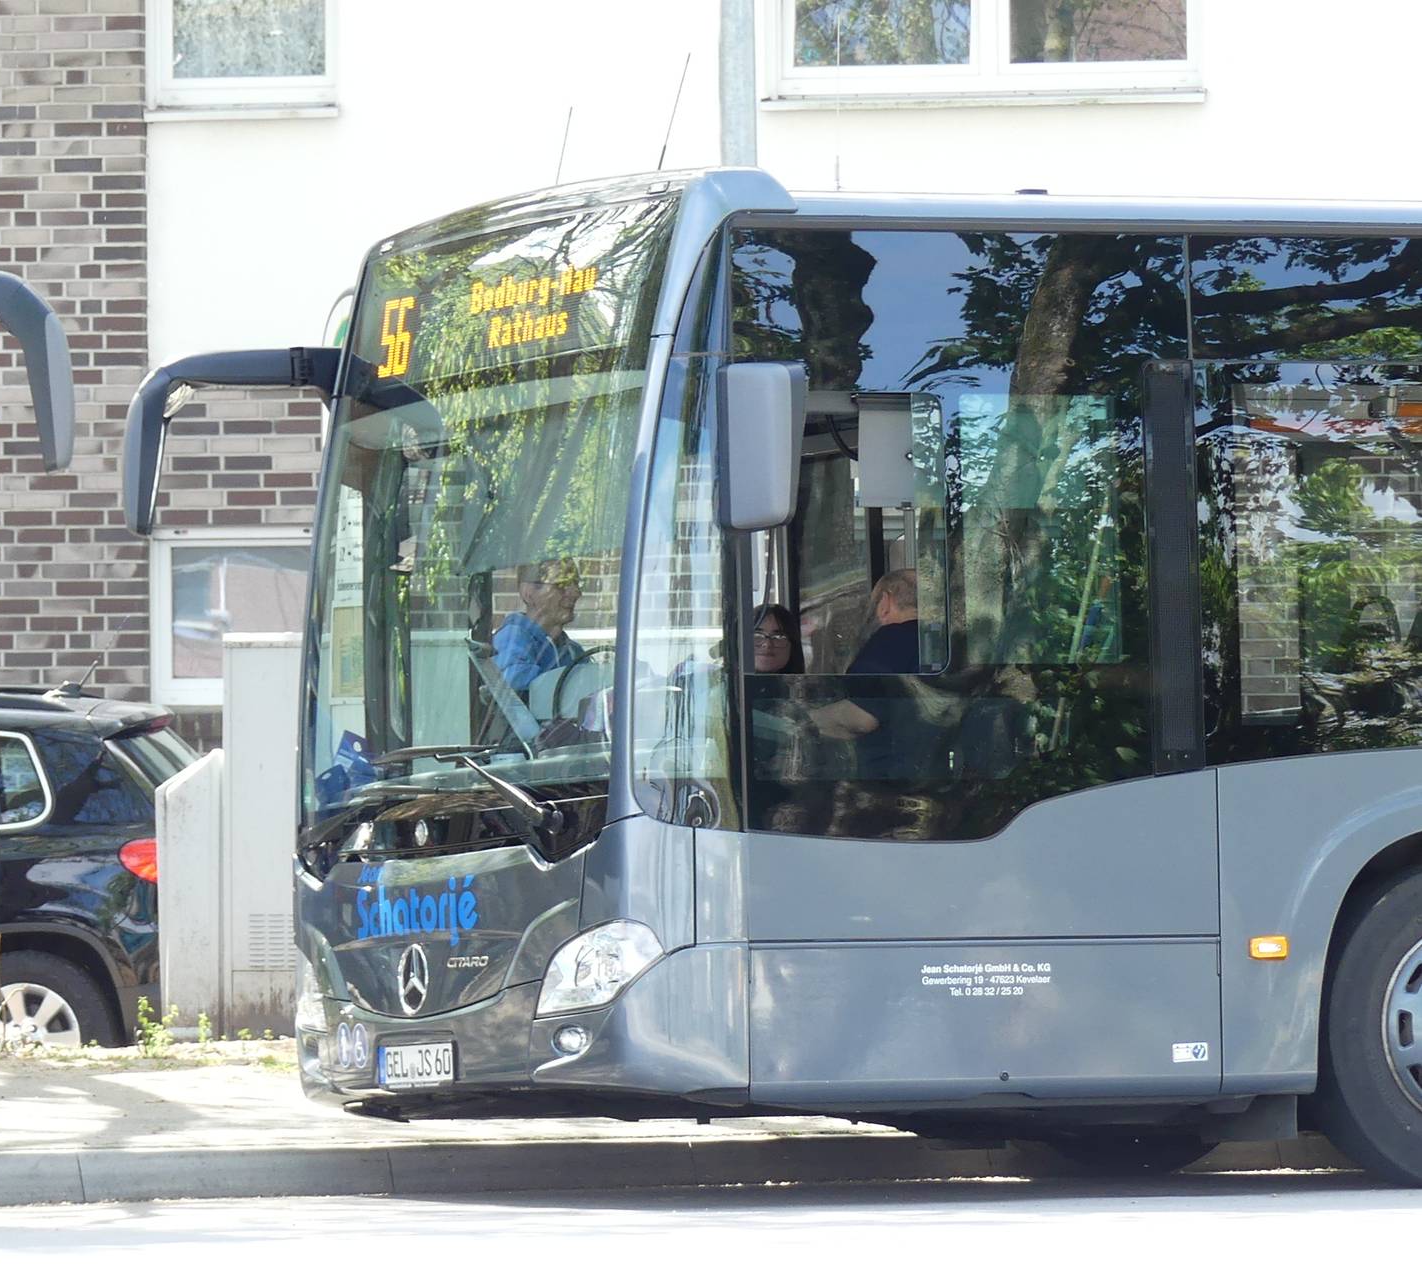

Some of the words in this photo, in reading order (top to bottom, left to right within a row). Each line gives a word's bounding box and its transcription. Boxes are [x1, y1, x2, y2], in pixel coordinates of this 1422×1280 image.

[469, 264, 600, 315] Bedburg-Hau
[377, 296, 416, 379] 56
[487, 311, 569, 349] Rathaus
[357, 875, 479, 947] Schatorjé
[447, 956, 489, 968] CITARO
[921, 964, 942, 974] Jean
[943, 963, 984, 975] Schatorjé
[984, 963, 1011, 973] GmbH
[1012, 963, 1020, 973] &
[1021, 963, 1036, 972] Co.
[1037, 963, 1051, 972] KG
[922, 975, 972, 986] Gewerbering
[974, 975, 984, 984] 19
[989, 975, 1015, 984] 47623
[1016, 975, 1051, 984] Kevelaer
[949, 987, 964, 996] Tel.
[965, 987, 971, 996] 0
[972, 987, 983, 996] 28
[984, 987, 995, 996] 32
[1001, 987, 1012, 996] 25
[1012, 987, 1024, 996] 20
[385, 1050, 409, 1079] GEL
[417, 1049, 432, 1077] JS
[435, 1048, 451, 1076] 60
